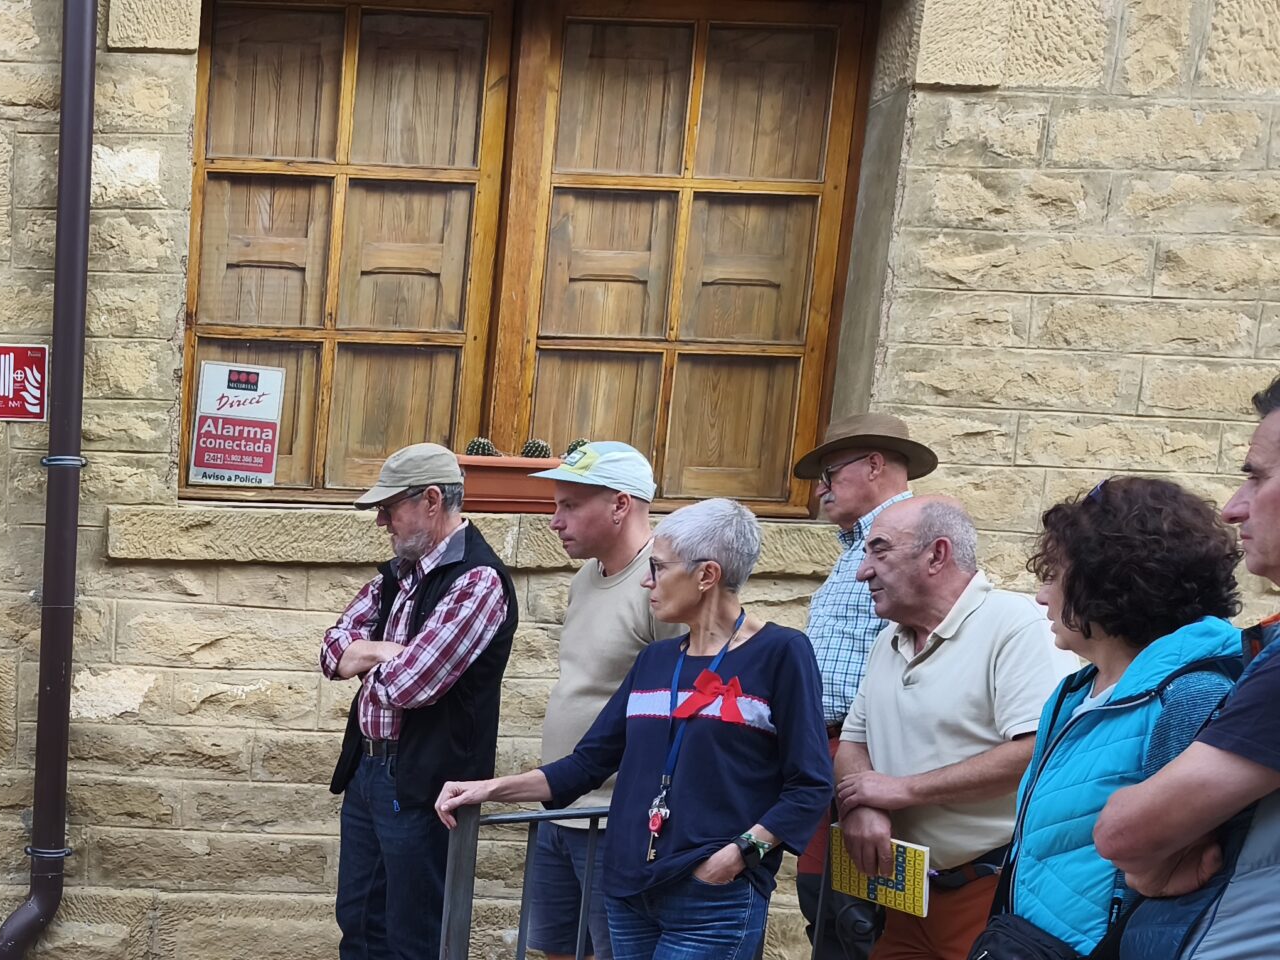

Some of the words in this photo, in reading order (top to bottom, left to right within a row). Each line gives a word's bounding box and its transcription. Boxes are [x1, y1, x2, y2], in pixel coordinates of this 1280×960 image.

[228, 382, 257, 390] SECURITAS
[216, 392, 271, 411] Direct
[201, 419, 273, 440] Alarma
[200, 437, 272, 453] conectada
[205, 453, 223, 463] 24H
[201, 471, 225, 481] Aviso
[234, 474, 263, 484] Policía
